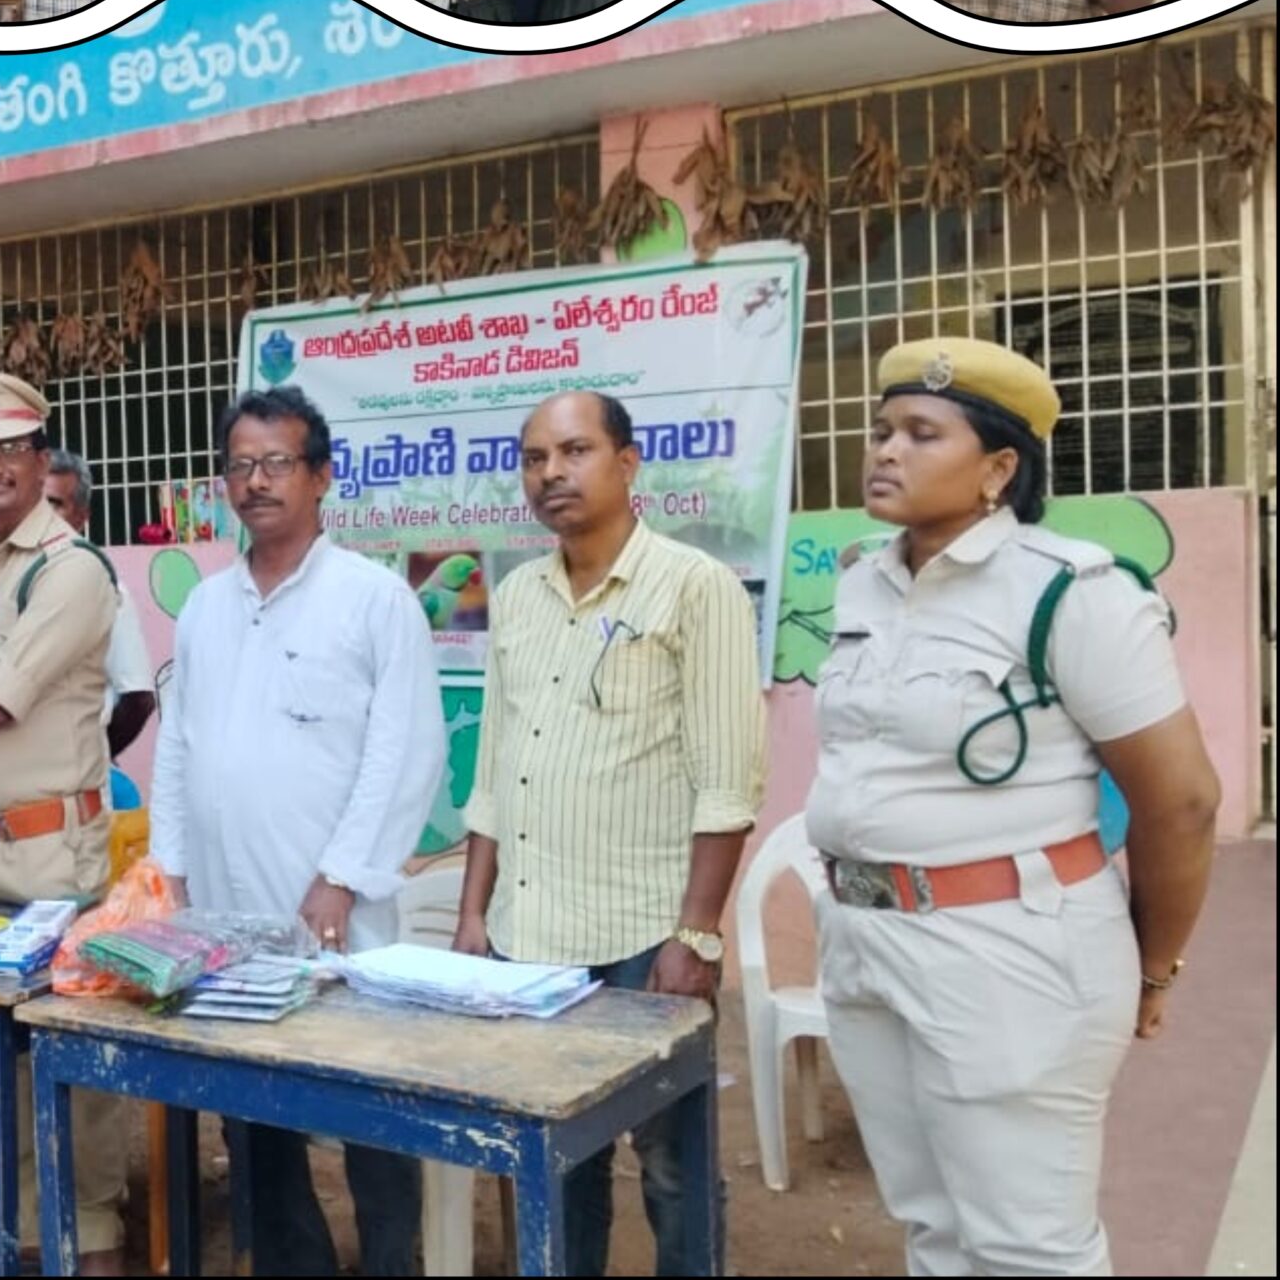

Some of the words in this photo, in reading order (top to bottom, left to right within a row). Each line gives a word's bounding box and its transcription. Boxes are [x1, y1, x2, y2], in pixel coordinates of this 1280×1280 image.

[414, 351, 499, 383] కాకినాడ
[331, 427, 456, 499] న్యప్రాణి
[322, 508, 346, 528] ild
[353, 506, 384, 528] Life
[392, 504, 439, 526] Week
[664, 492, 707, 520] Oct)
